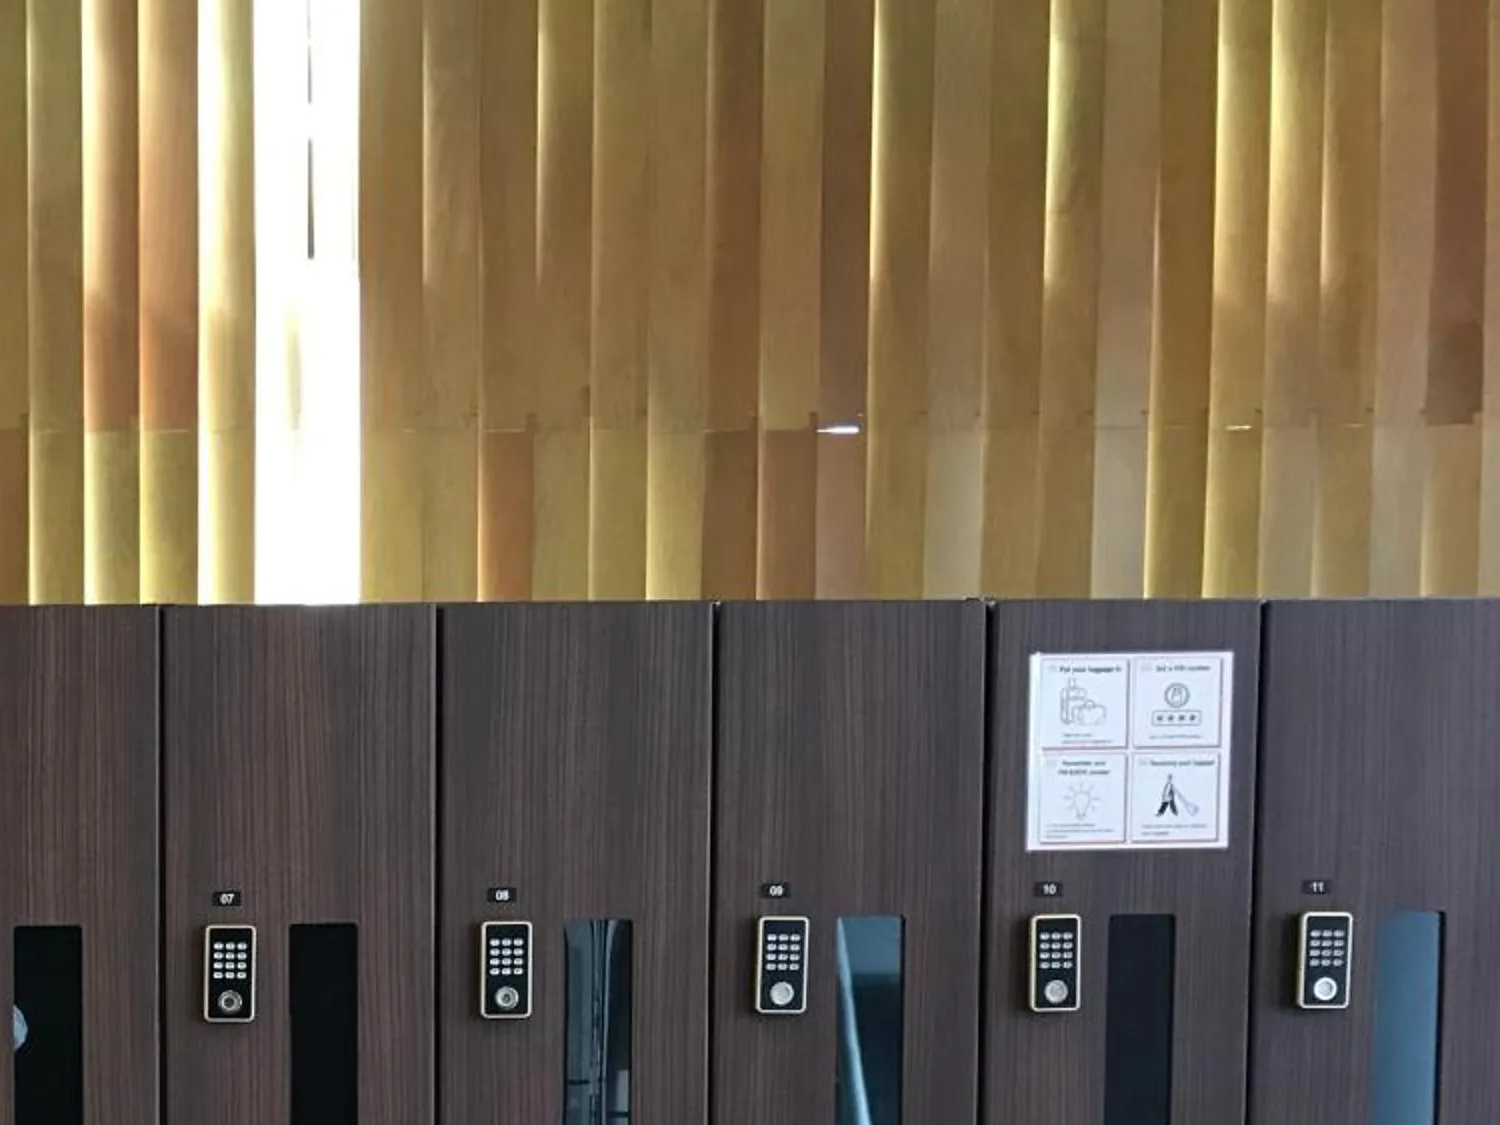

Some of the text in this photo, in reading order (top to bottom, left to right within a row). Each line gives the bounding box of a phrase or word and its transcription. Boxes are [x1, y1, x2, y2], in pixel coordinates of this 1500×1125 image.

[1043, 883, 1057, 894] 10
[1312, 881, 1324, 892] 11
[220, 893, 235, 905] 07
